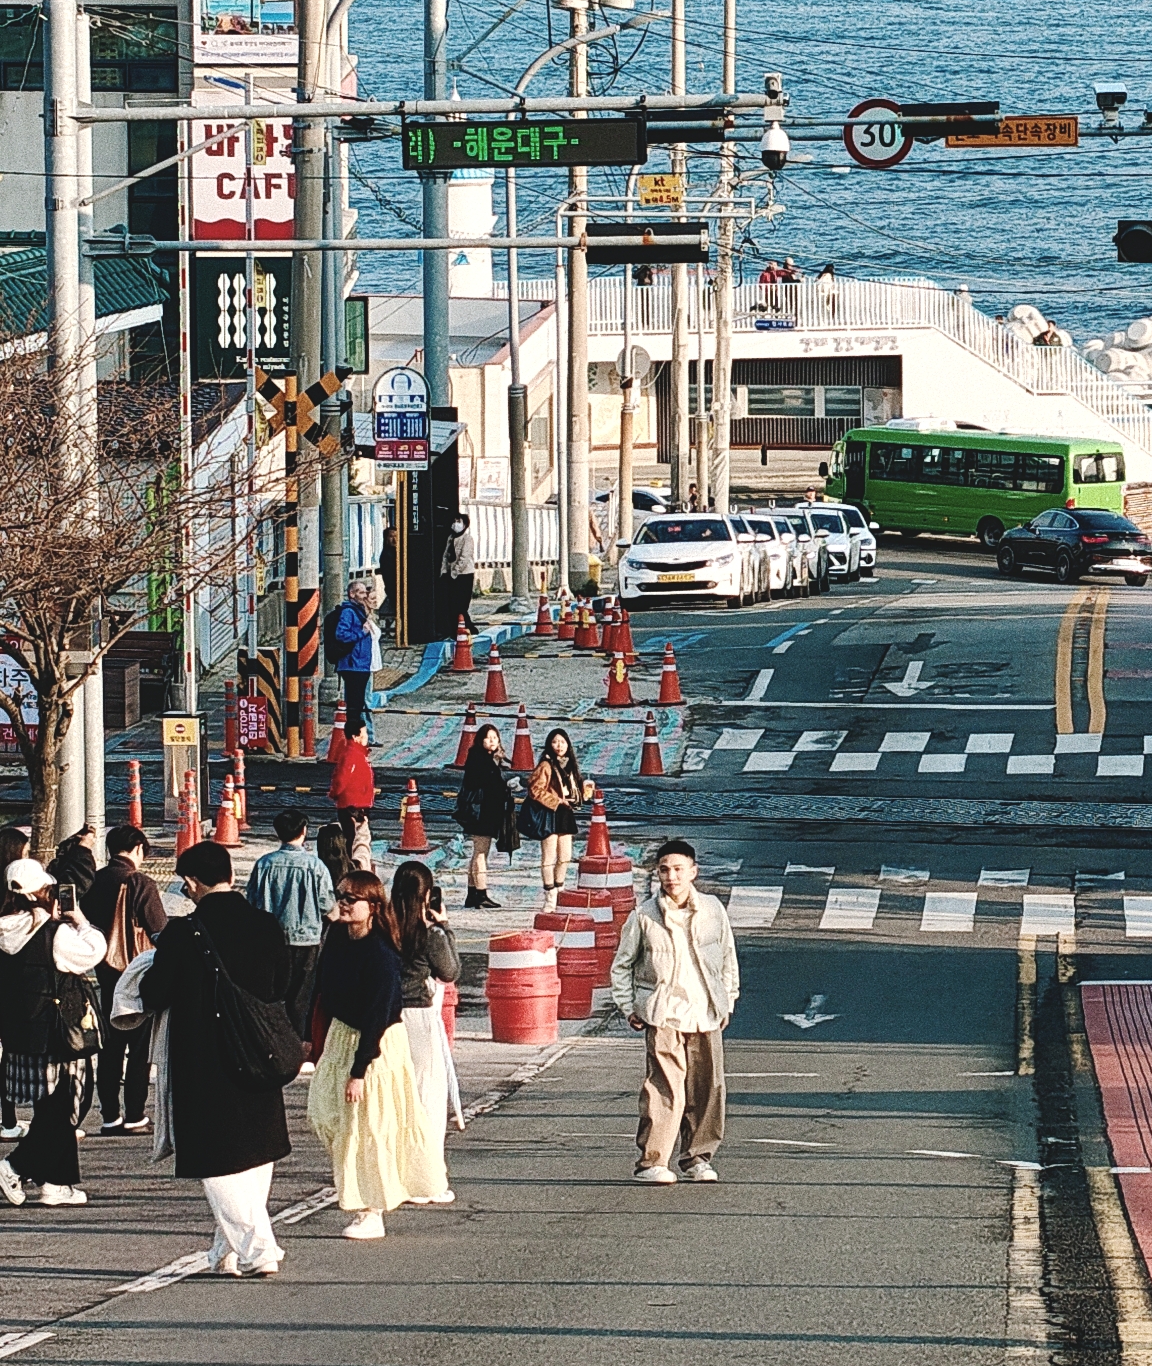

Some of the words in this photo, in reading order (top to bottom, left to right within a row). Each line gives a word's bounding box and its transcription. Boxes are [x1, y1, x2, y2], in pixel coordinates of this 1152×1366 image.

[860, 123, 896, 147] 30
[653, 176, 666, 187] kt
[240, 709, 248, 734] STOP
